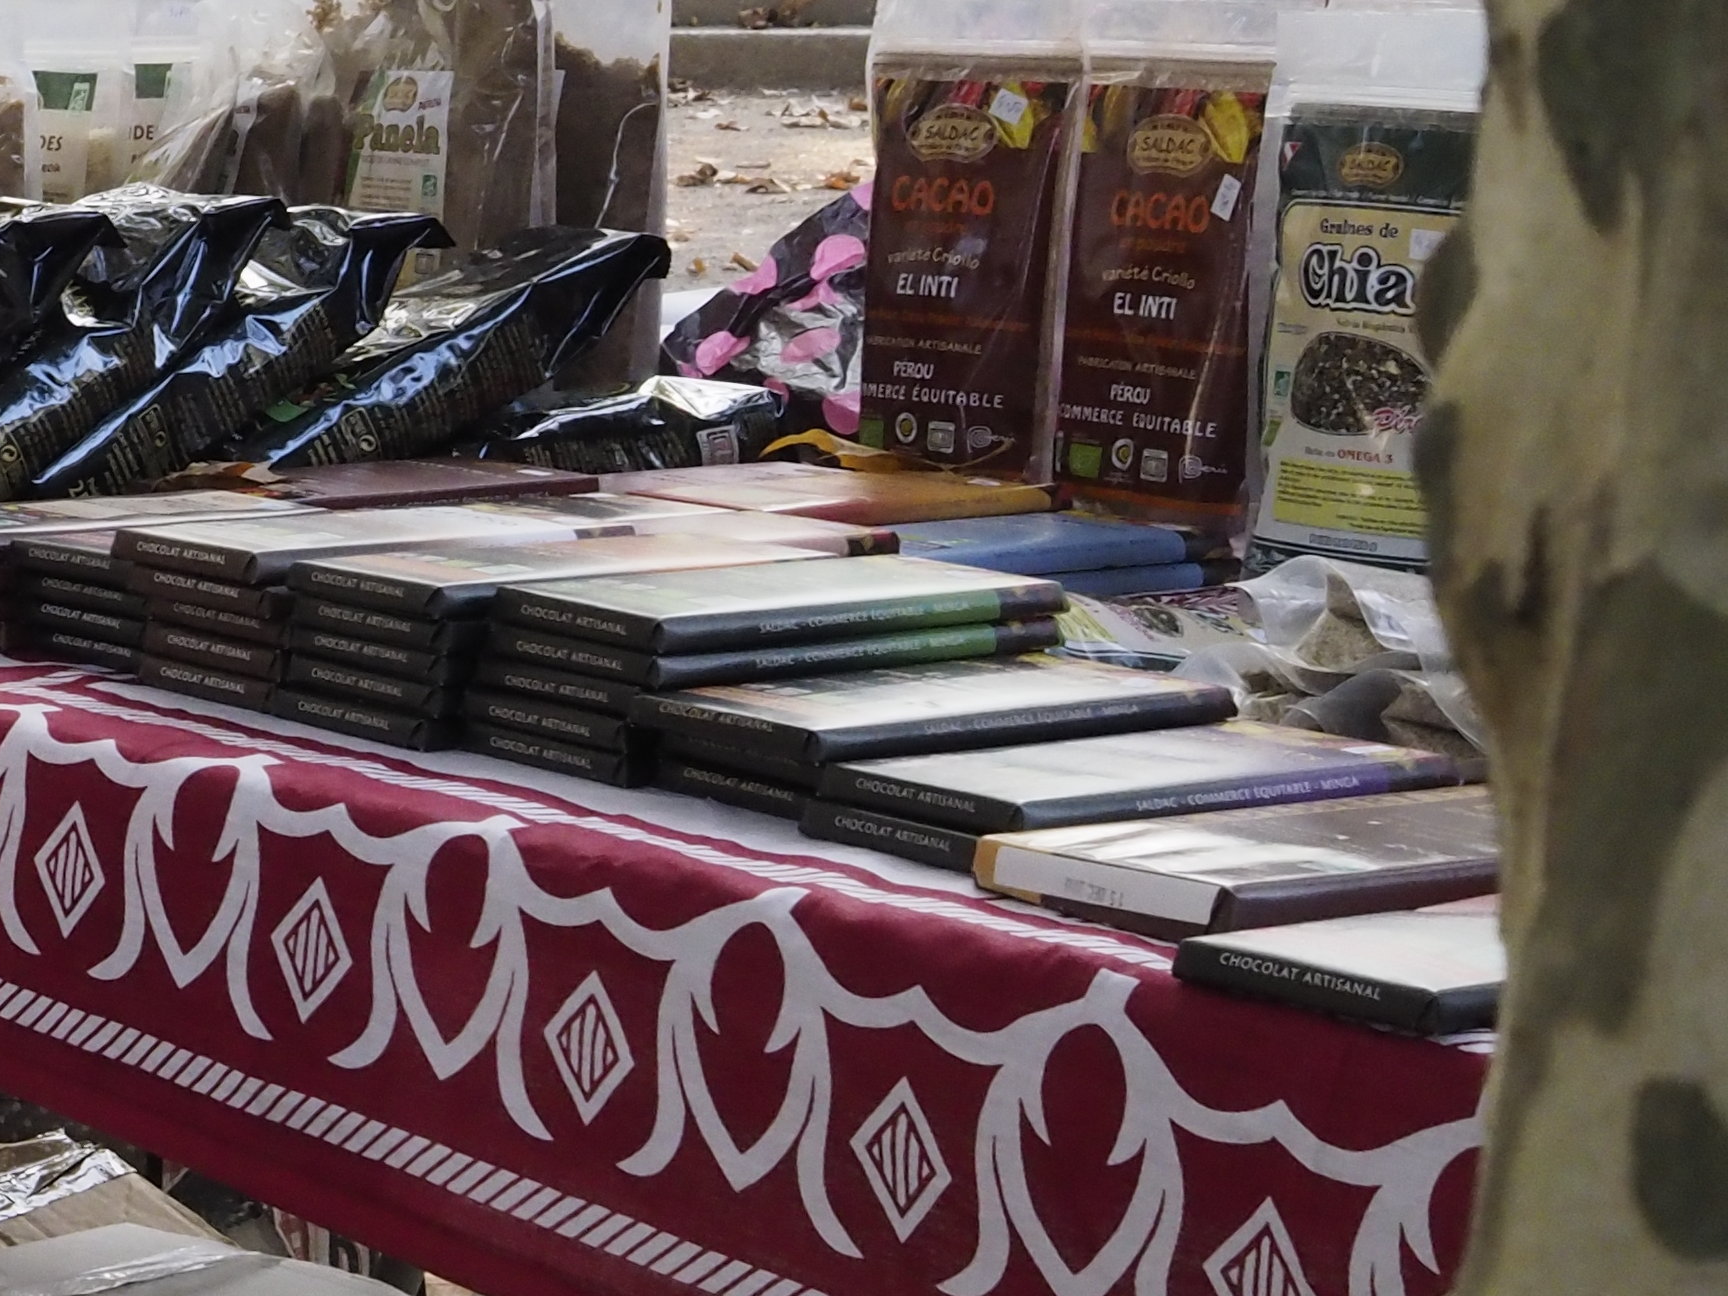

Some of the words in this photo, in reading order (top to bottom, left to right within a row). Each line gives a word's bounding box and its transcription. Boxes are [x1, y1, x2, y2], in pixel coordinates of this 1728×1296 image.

[923, 124, 980, 142] SALDAC
[1141, 135, 1195, 154] SALDAC
[892, 175, 995, 216] CACAO
[1111, 190, 1211, 233] CACAO
[1320, 218, 1374, 236] Graines
[1379, 223, 1398, 239] de
[896, 272, 915, 295] EL
[919, 274, 959, 298] INTI
[1151, 266, 1195, 290] Criollo
[1301, 242, 1416, 315] Chia
[1113, 292, 1134, 315] EL
[1138, 295, 1177, 320] INTI
[912, 382, 1004, 408] ÉQUITABLE
[1109, 382, 1152, 405] PÉROU
[1059, 403, 1124, 426] COMMERCE
[1337, 448, 1381, 463] OMEGA
[1384, 453, 1393, 464] 3
[136, 540, 182, 559] CHOCOLAT
[182, 547, 226, 565] ARTISANAL
[153, 572, 197, 590] CHOCOLAT
[196, 579, 241, 598] ARTISANAL
[311, 570, 358, 589] CHOCOLAT
[359, 581, 405, 598] ARTISANAL
[520, 604, 574, 623] CHOCOLAT
[575, 615, 627, 636] ARTISANAL
[166, 634, 209, 651] CHOCOLAT
[314, 635, 361, 653] CHOCOLAT
[515, 640, 569, 660] CHOCOLAT
[570, 651, 623, 671] ARTISANAL
[159, 666, 204, 684] CHOCOLAT
[203, 675, 246, 694] ARTISANAL
[311, 667, 357, 686] CHOCOLAT
[504, 674, 556, 694] CHOCOLAT
[488, 705, 540, 724] CHOCOLAT
[489, 736, 541, 756] CHOCOLAT
[855, 777, 915, 799] CHOCOLAT
[917, 790, 976, 813] ARTISANAL
[1135, 796, 1179, 812] SALDAC
[1186, 789, 1250, 807] COMMERCE
[834, 815, 893, 836] CHOCOLAT
[895, 829, 952, 853] ARTISANAL
[1219, 952, 1300, 981] CHOCOLAT
[1302, 970, 1381, 1001] ARTISANAL
